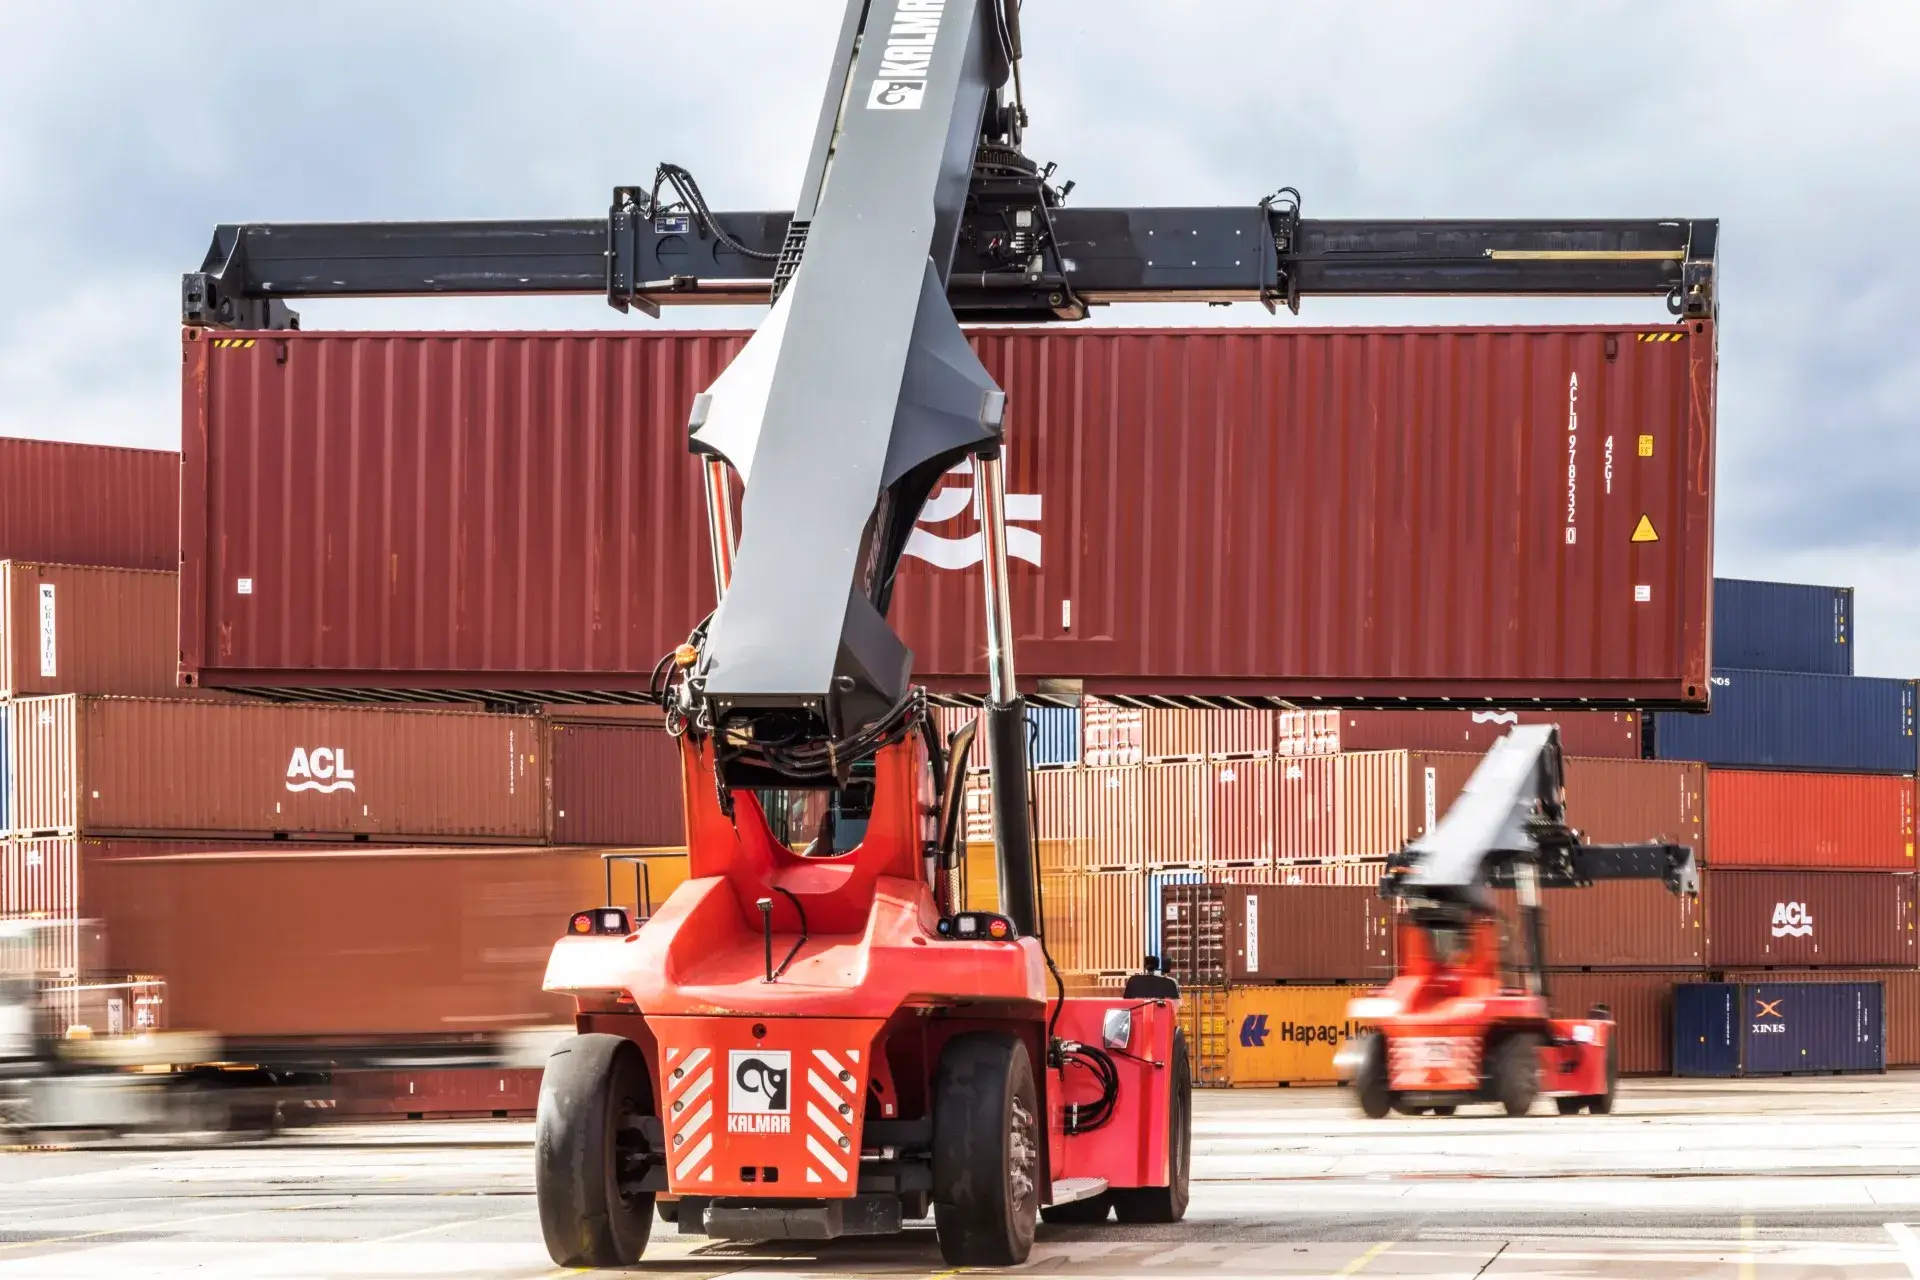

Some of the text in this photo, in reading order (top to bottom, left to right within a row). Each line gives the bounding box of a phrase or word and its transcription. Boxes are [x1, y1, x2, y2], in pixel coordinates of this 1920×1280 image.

[1568, 372, 1578, 430] ACLU
[1568, 435, 1577, 522] 978532
[1604, 435, 1613, 494] 45G1
[919, 444, 1042, 523] CL
[1711, 677, 1731, 686] NOS
[286, 747, 355, 779] ACL
[1772, 902, 1813, 925] ACL
[1281, 1021, 1380, 1046] Hapag-Llo
[1752, 1023, 1786, 1033] XINES
[727, 1114, 791, 1134] KALMAR
